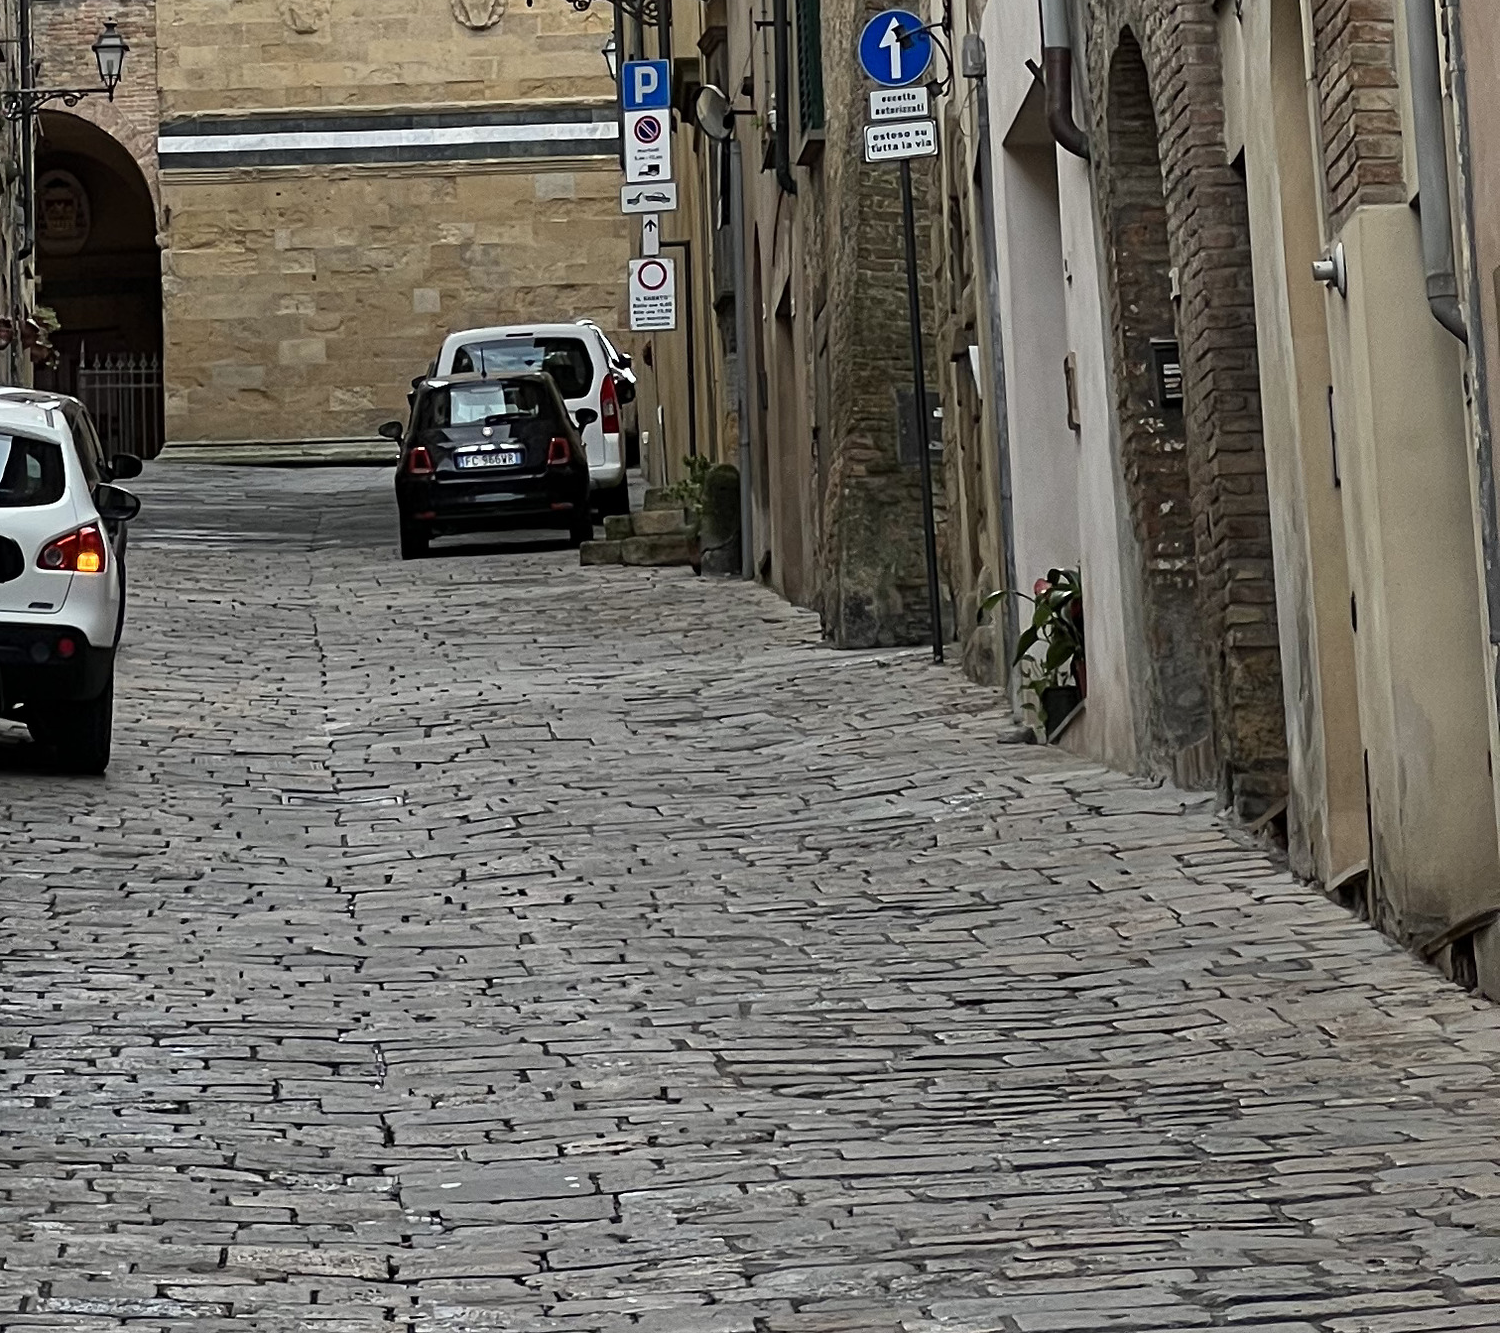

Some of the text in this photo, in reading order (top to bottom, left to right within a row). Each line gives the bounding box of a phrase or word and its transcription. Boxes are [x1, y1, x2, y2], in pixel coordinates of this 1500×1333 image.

[634, 66, 658, 103] P
[872, 129, 928, 141] esteso su
[871, 139, 932, 153] tutta la via
